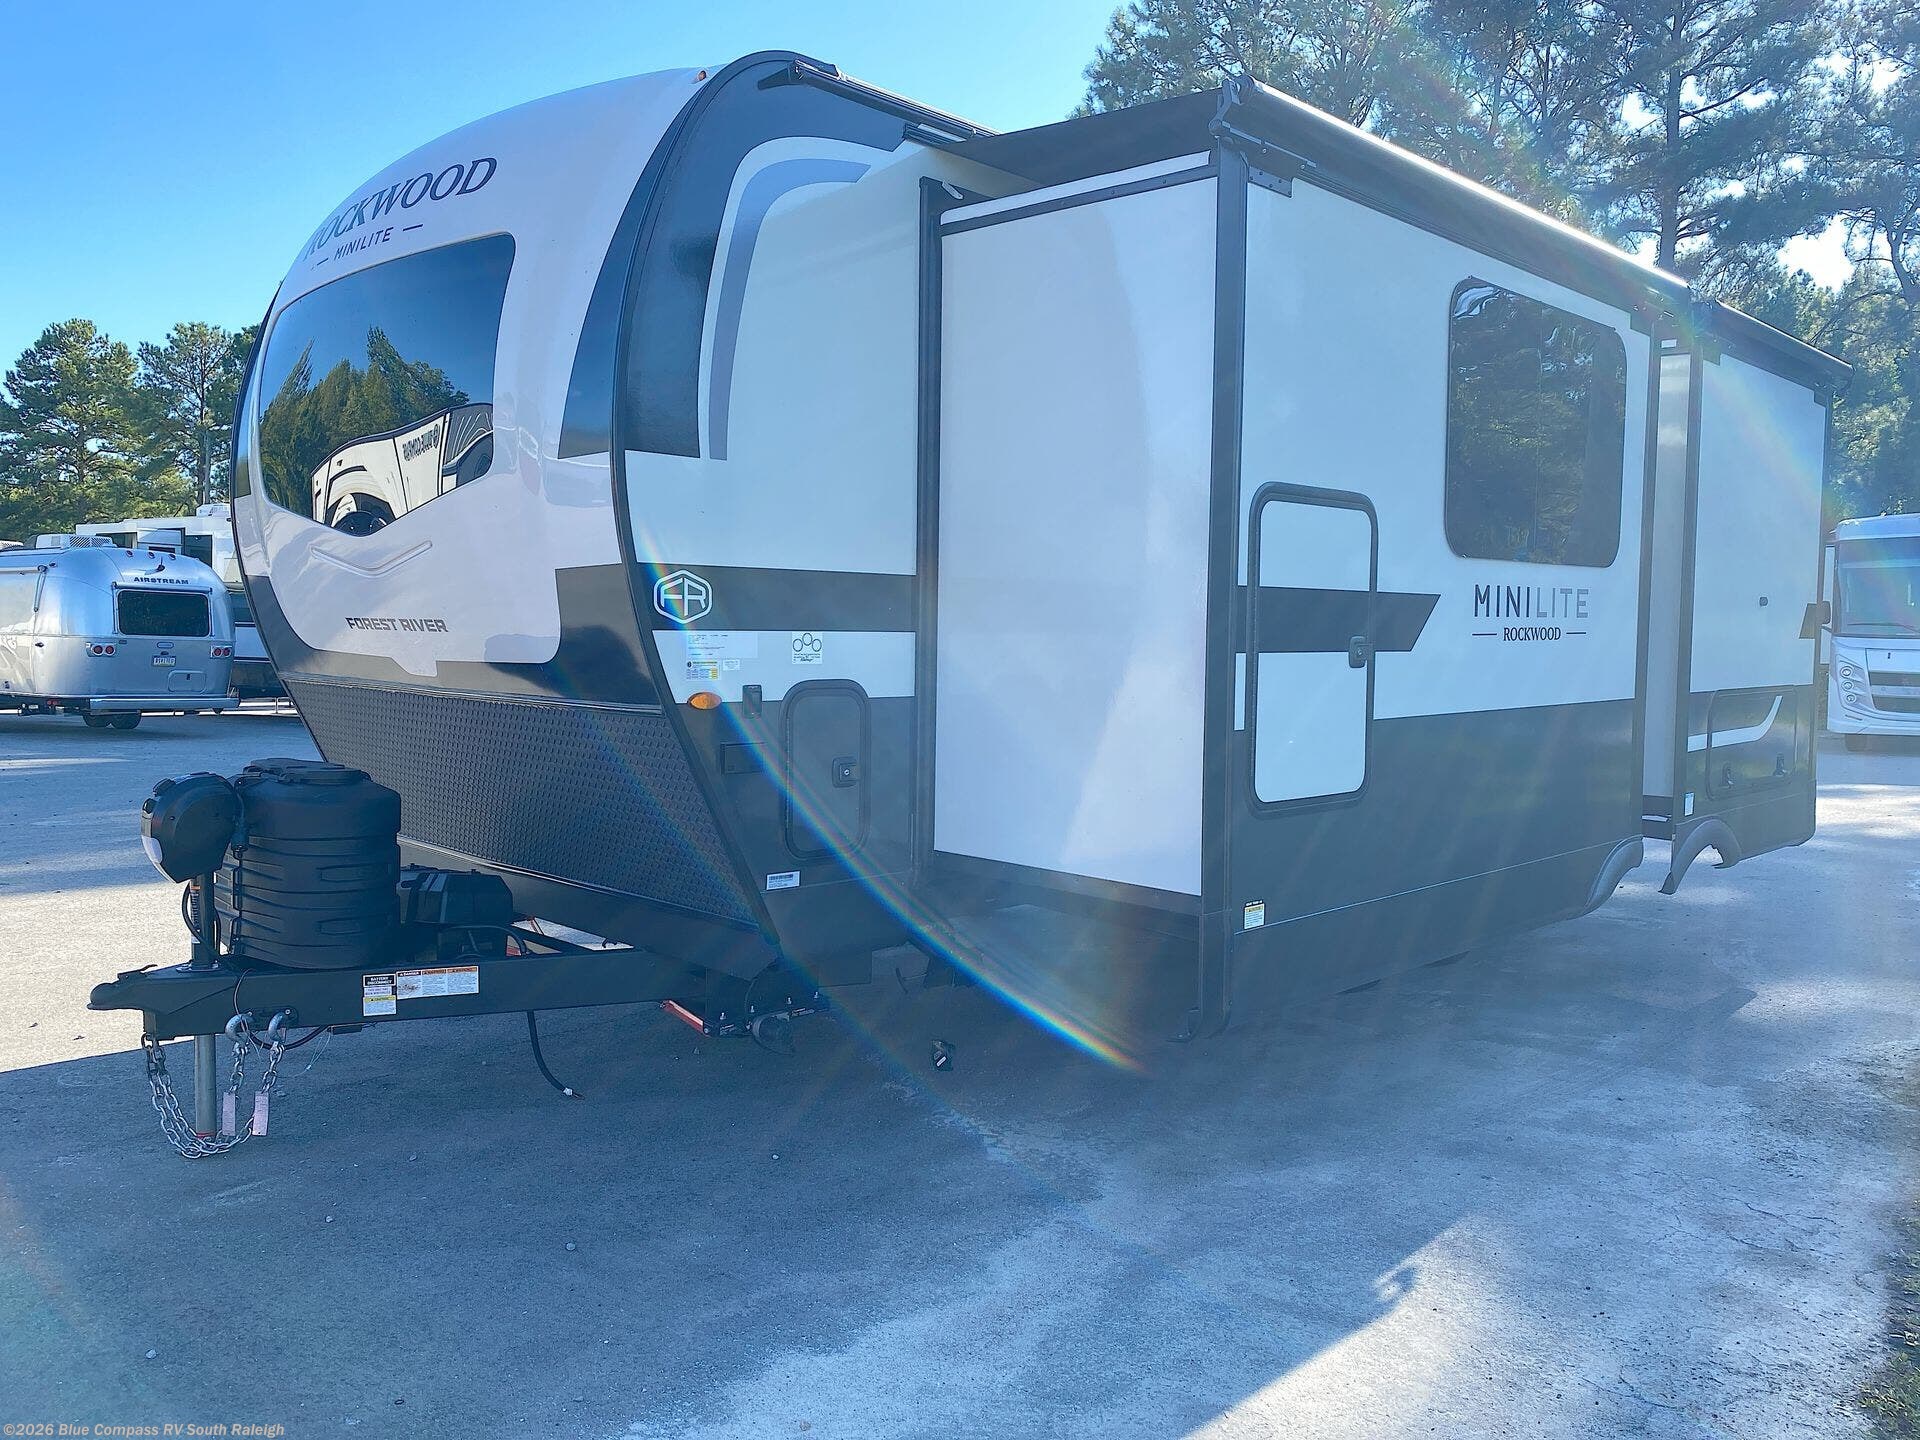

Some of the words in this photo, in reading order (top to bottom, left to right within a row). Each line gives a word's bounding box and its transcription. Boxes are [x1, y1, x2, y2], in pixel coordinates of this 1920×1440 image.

[303, 157, 498, 262] ROCKWOOD
[333, 227, 395, 261] MINILITE
[134, 577, 189, 585] AIRSTREAM
[1474, 584, 1589, 618] MINILITE
[345, 617, 398, 631] FOREST
[399, 618, 449, 632] RIVER
[1503, 626, 1561, 641] ROCKWOOD
